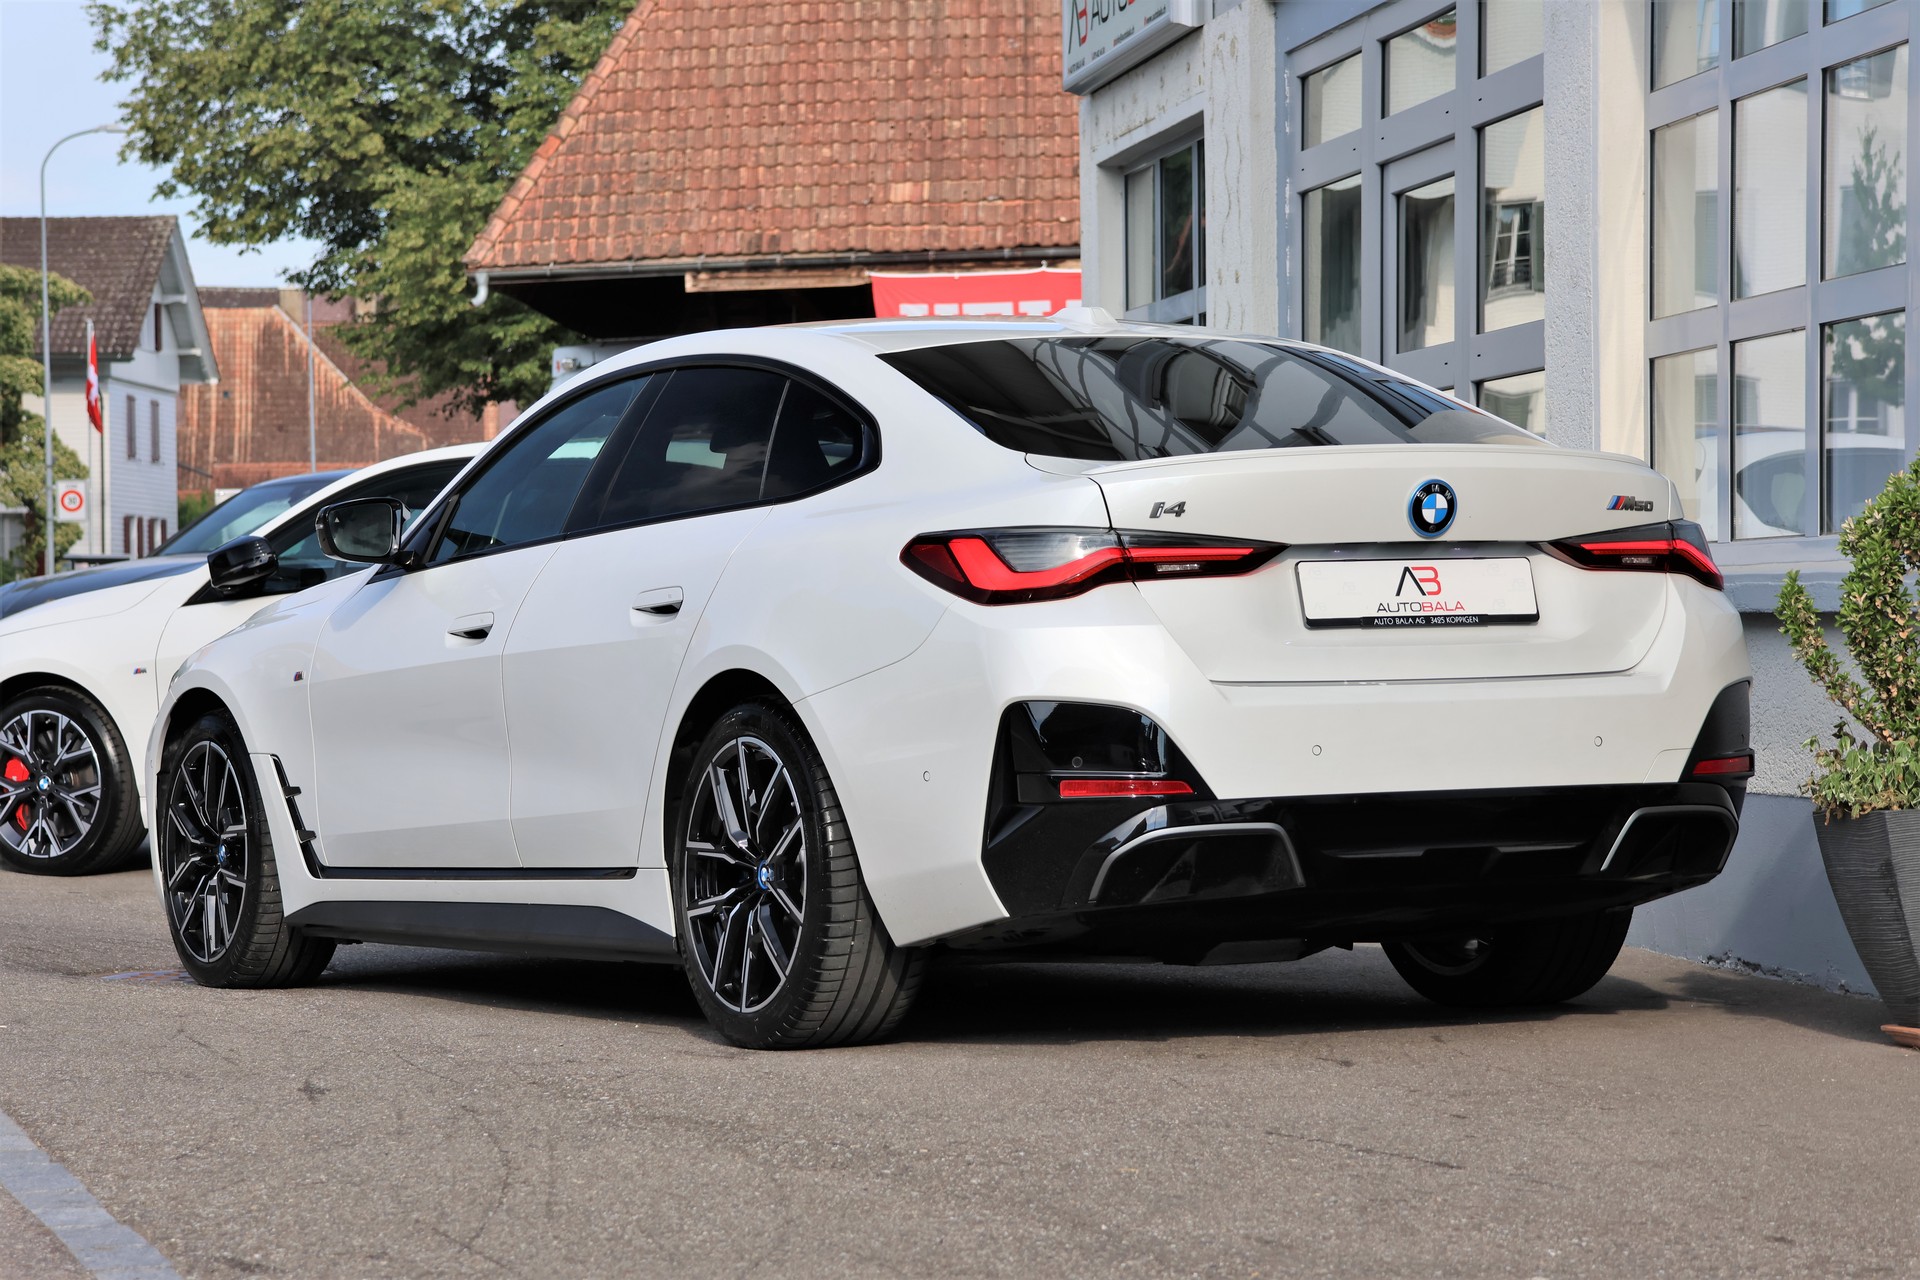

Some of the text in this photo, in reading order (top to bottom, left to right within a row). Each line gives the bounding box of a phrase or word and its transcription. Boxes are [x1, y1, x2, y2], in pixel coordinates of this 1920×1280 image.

[1416, 484, 1453, 500] BMW
[1149, 501, 1186, 518] i4
[1395, 566, 1442, 596] AB
[1377, 601, 1465, 613] AUTOBALA
[1373, 617, 1394, 625] AUTO
[1395, 617, 1414, 625] BALA
[1415, 616, 1426, 624] AG
[1446, 615, 1479, 624] KOPPIGEN
